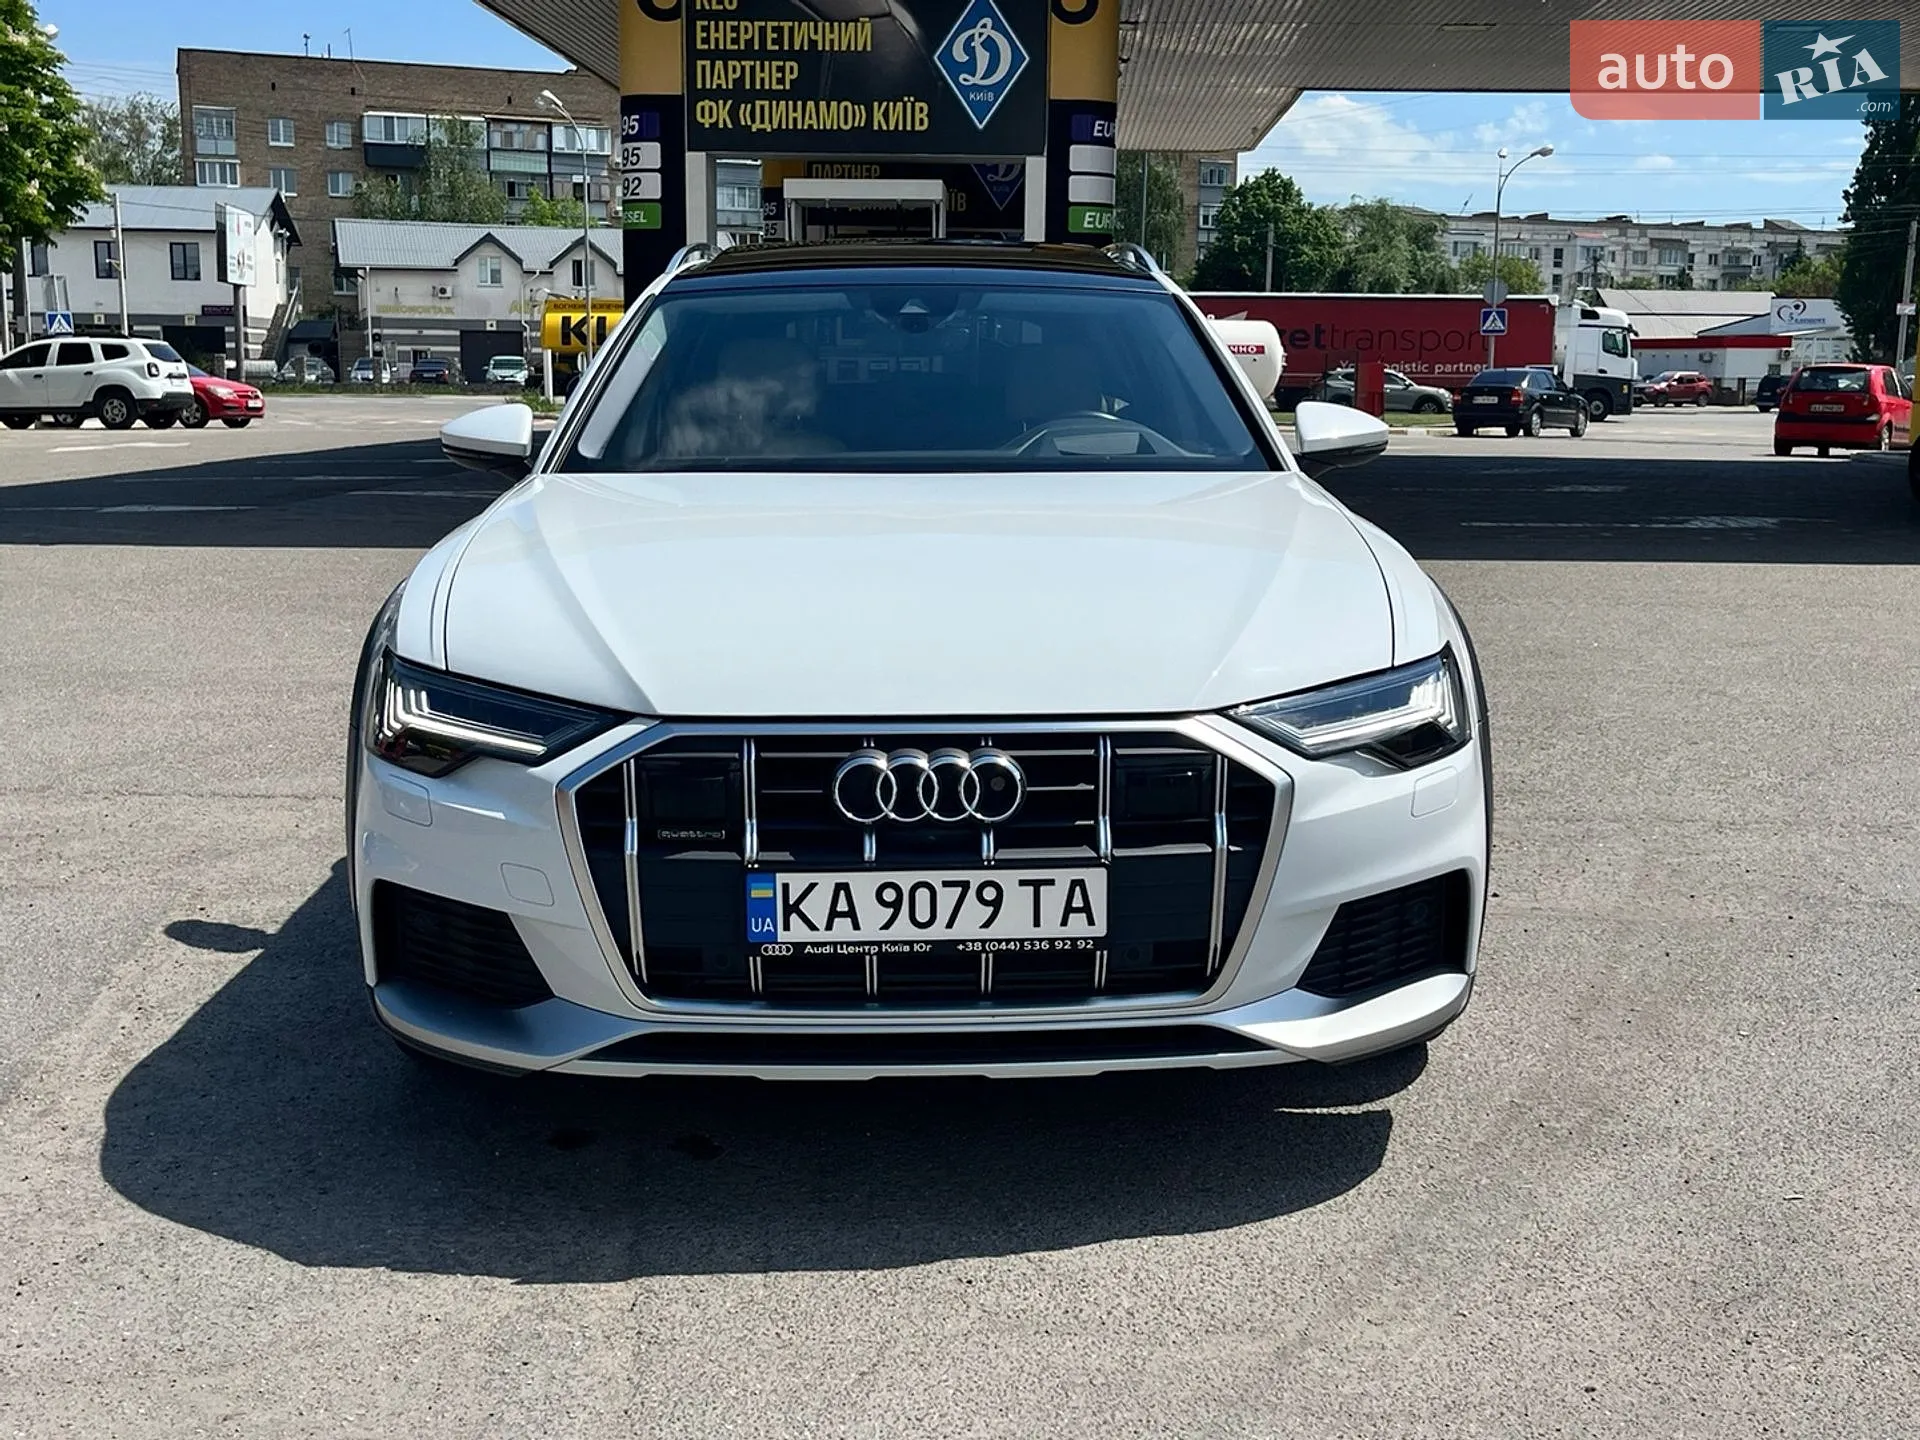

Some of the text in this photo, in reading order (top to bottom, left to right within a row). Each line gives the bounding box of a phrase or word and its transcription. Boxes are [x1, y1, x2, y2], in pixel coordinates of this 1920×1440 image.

[695, 17, 873, 52] ЕНЕРГЕТИЧНИЙ
[695, 59, 800, 91] ПАРТНЕР
[968, 89, 996, 103] КИЇВ
[621, 114, 640, 136] 95
[695, 95, 930, 133] ФК «ДИНАМО» КИЇВ
[621, 147, 642, 168] 95
[621, 176, 642, 198] 92
[1434, 361, 1489, 374] partner
[751, 878, 1096, 934] UA KA 9079 TA
[803, 939, 1095, 956] Audi Центр Київ Юг +38 (044) 536 92 92
